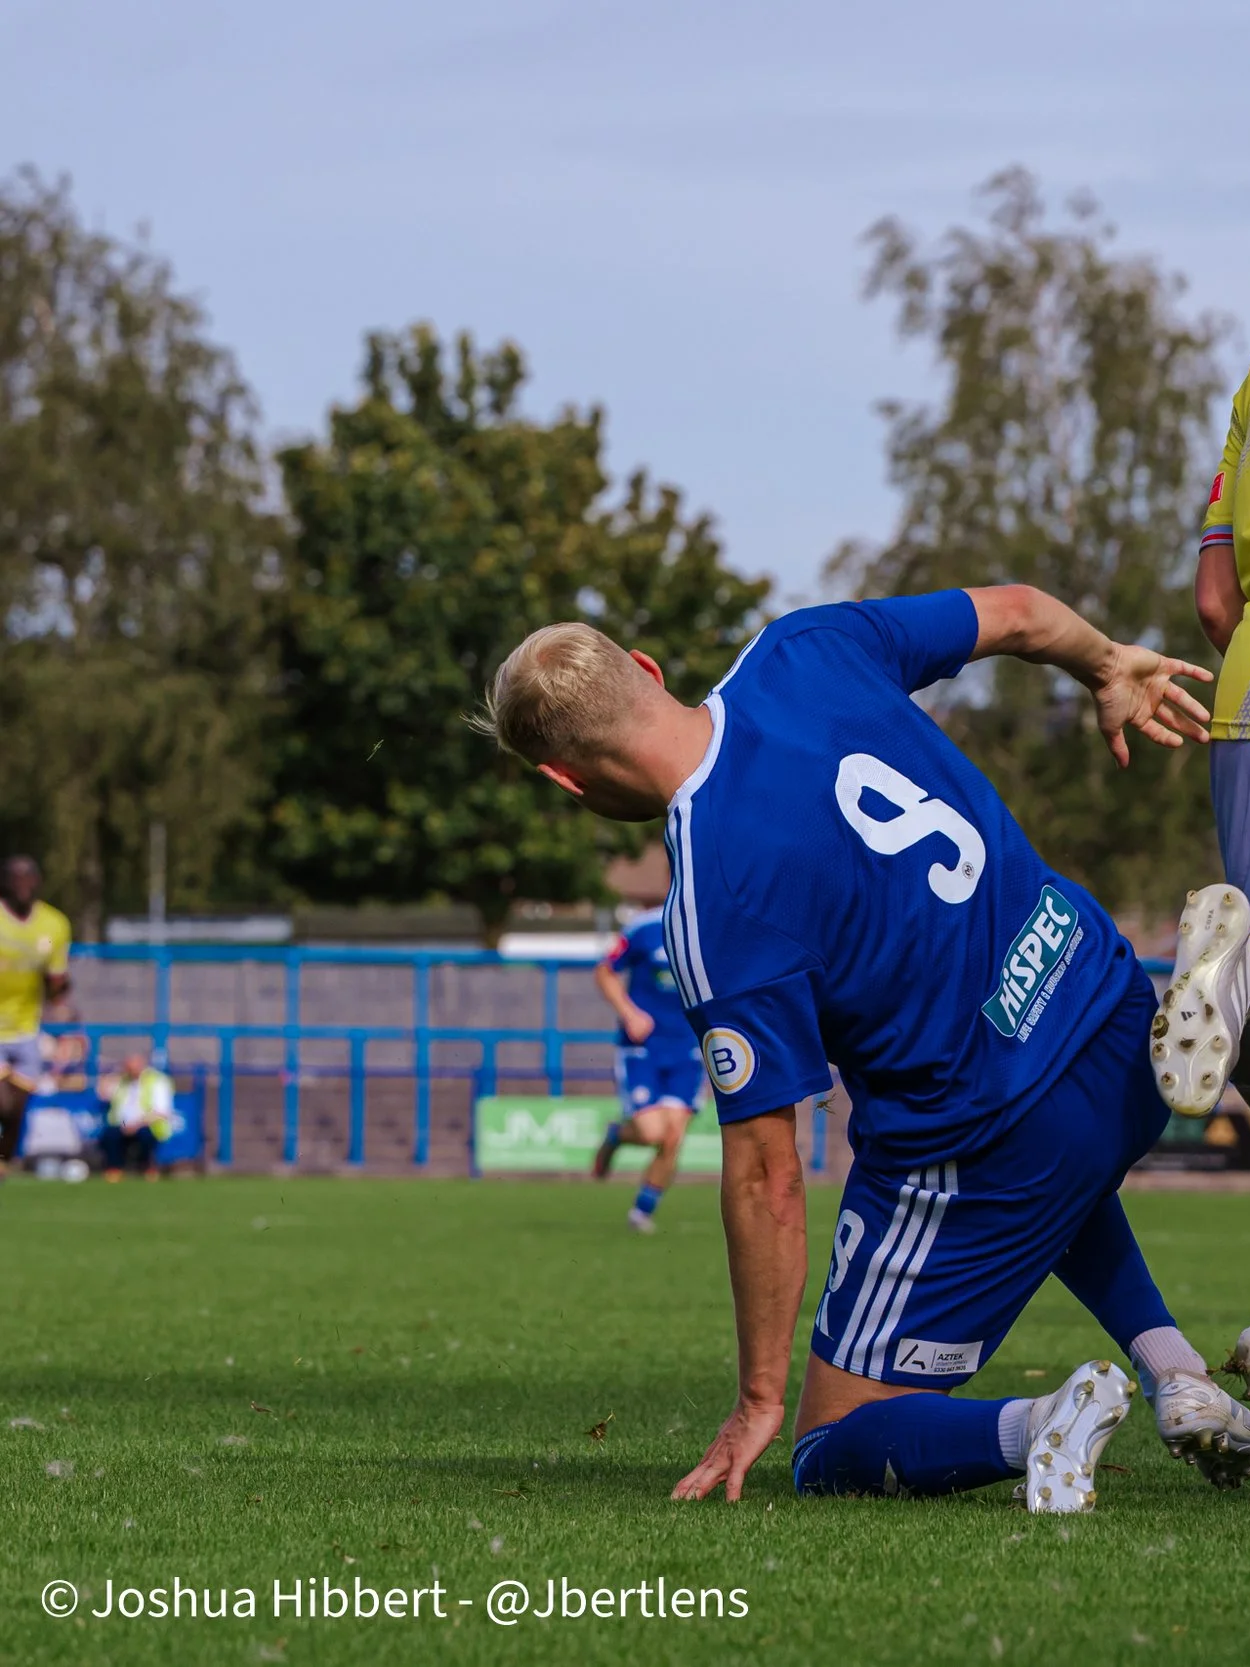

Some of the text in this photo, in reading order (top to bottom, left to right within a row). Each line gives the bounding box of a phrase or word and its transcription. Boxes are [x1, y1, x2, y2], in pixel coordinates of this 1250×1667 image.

[835, 753, 986, 904] 9
[711, 1047, 737, 1076] B
[828, 1209, 865, 1293] 9
[937, 1352, 965, 1361] AZTEK
